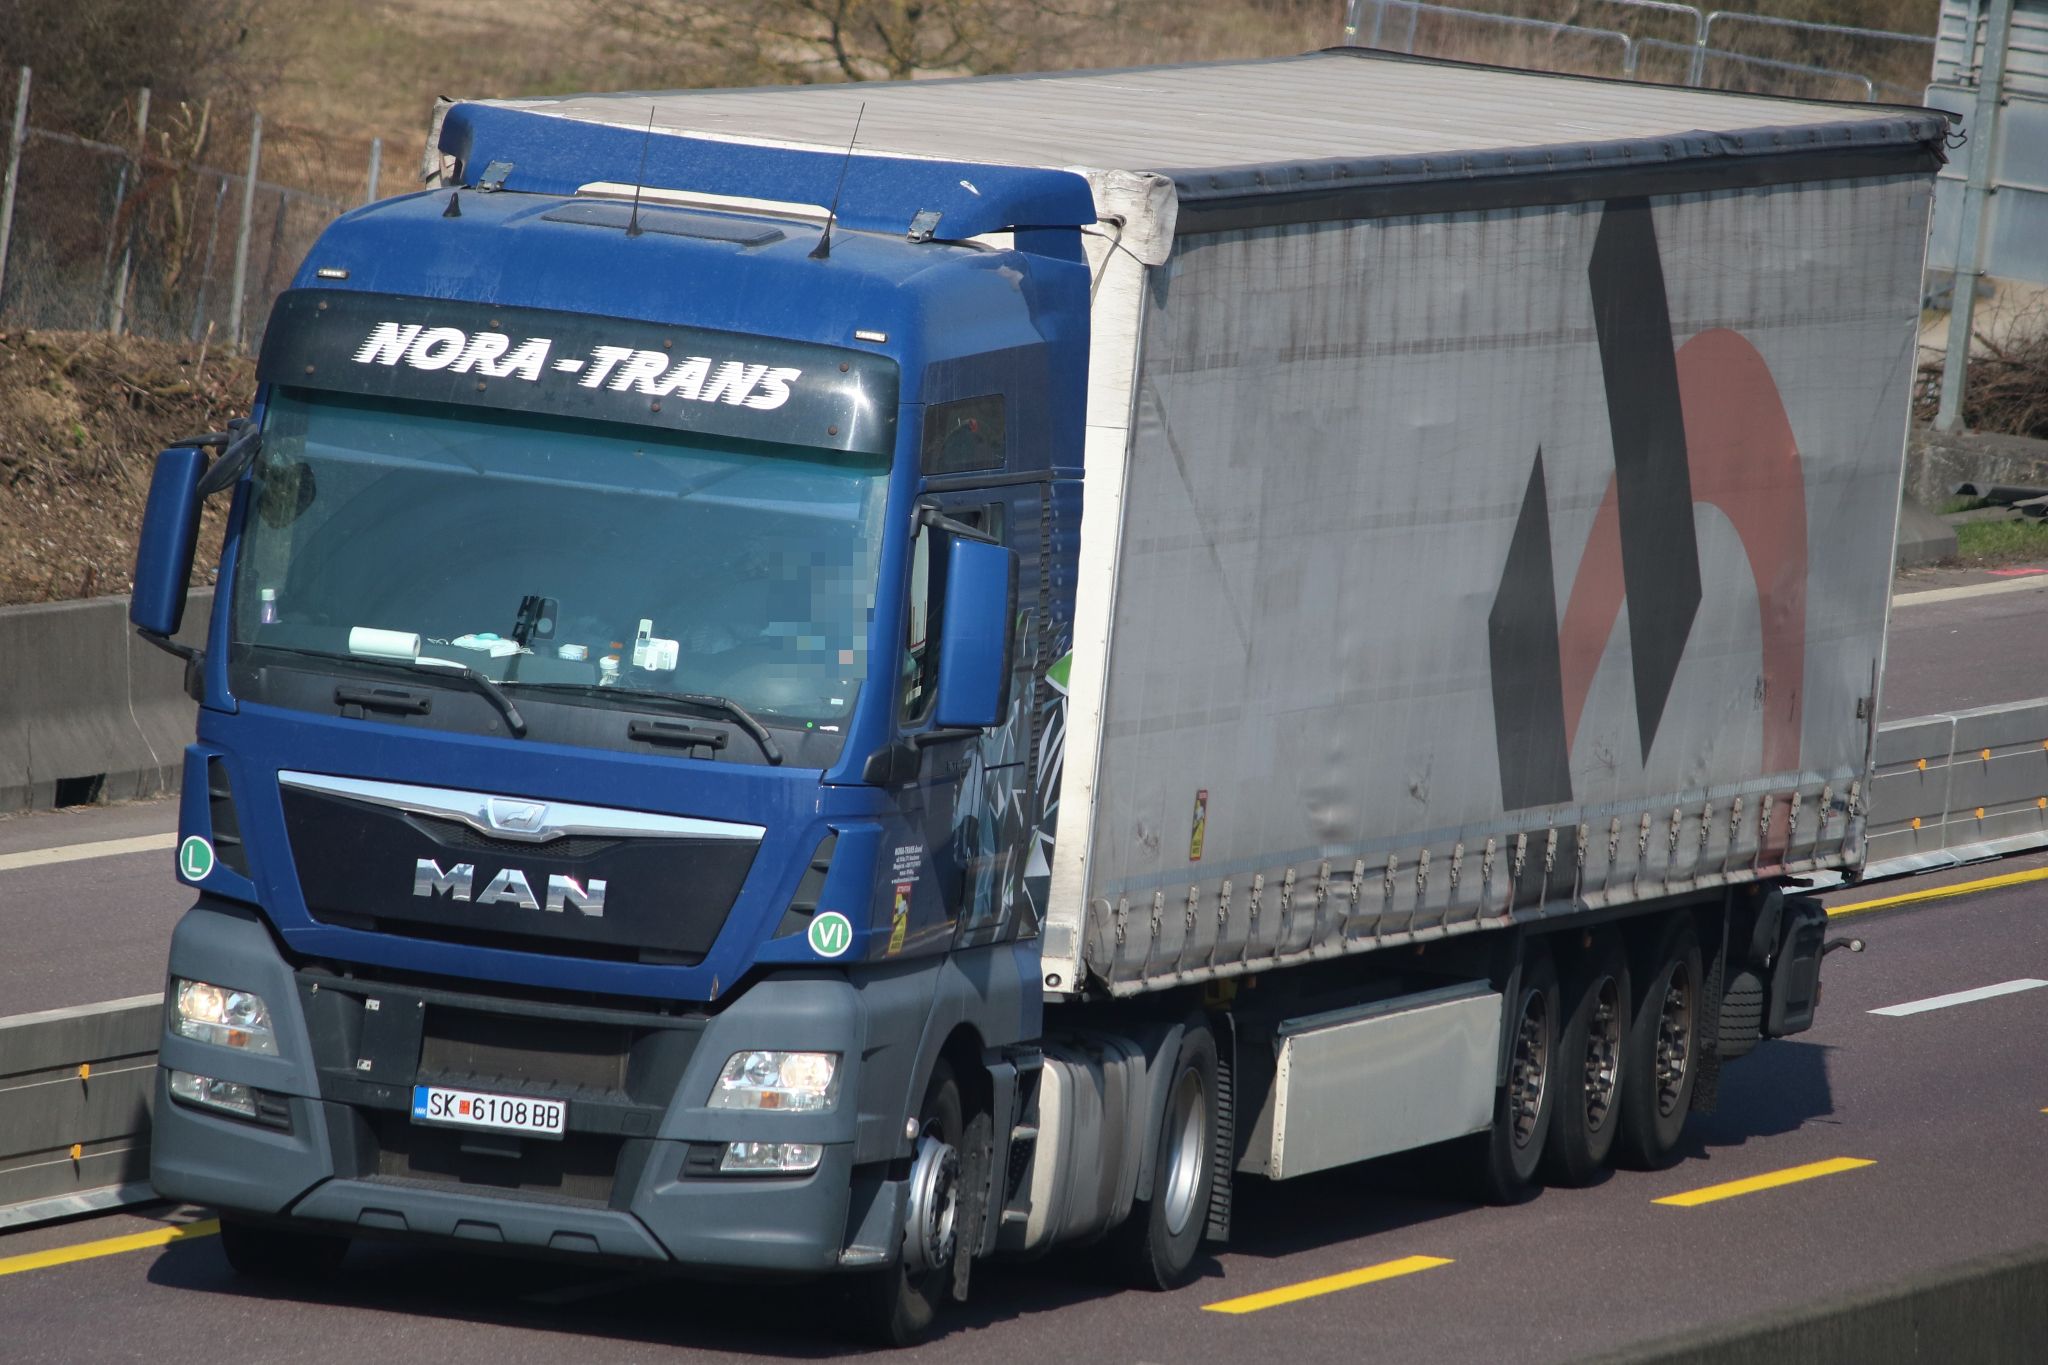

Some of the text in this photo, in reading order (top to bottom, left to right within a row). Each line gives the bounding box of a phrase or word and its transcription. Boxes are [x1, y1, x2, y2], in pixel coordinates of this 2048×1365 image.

[351, 321, 803, 411] NORA-TRANS
[188, 845, 202, 873] L
[413, 858, 607, 918] MAN
[818, 921, 843, 949] VI
[430, 1093, 457, 1118] SK
